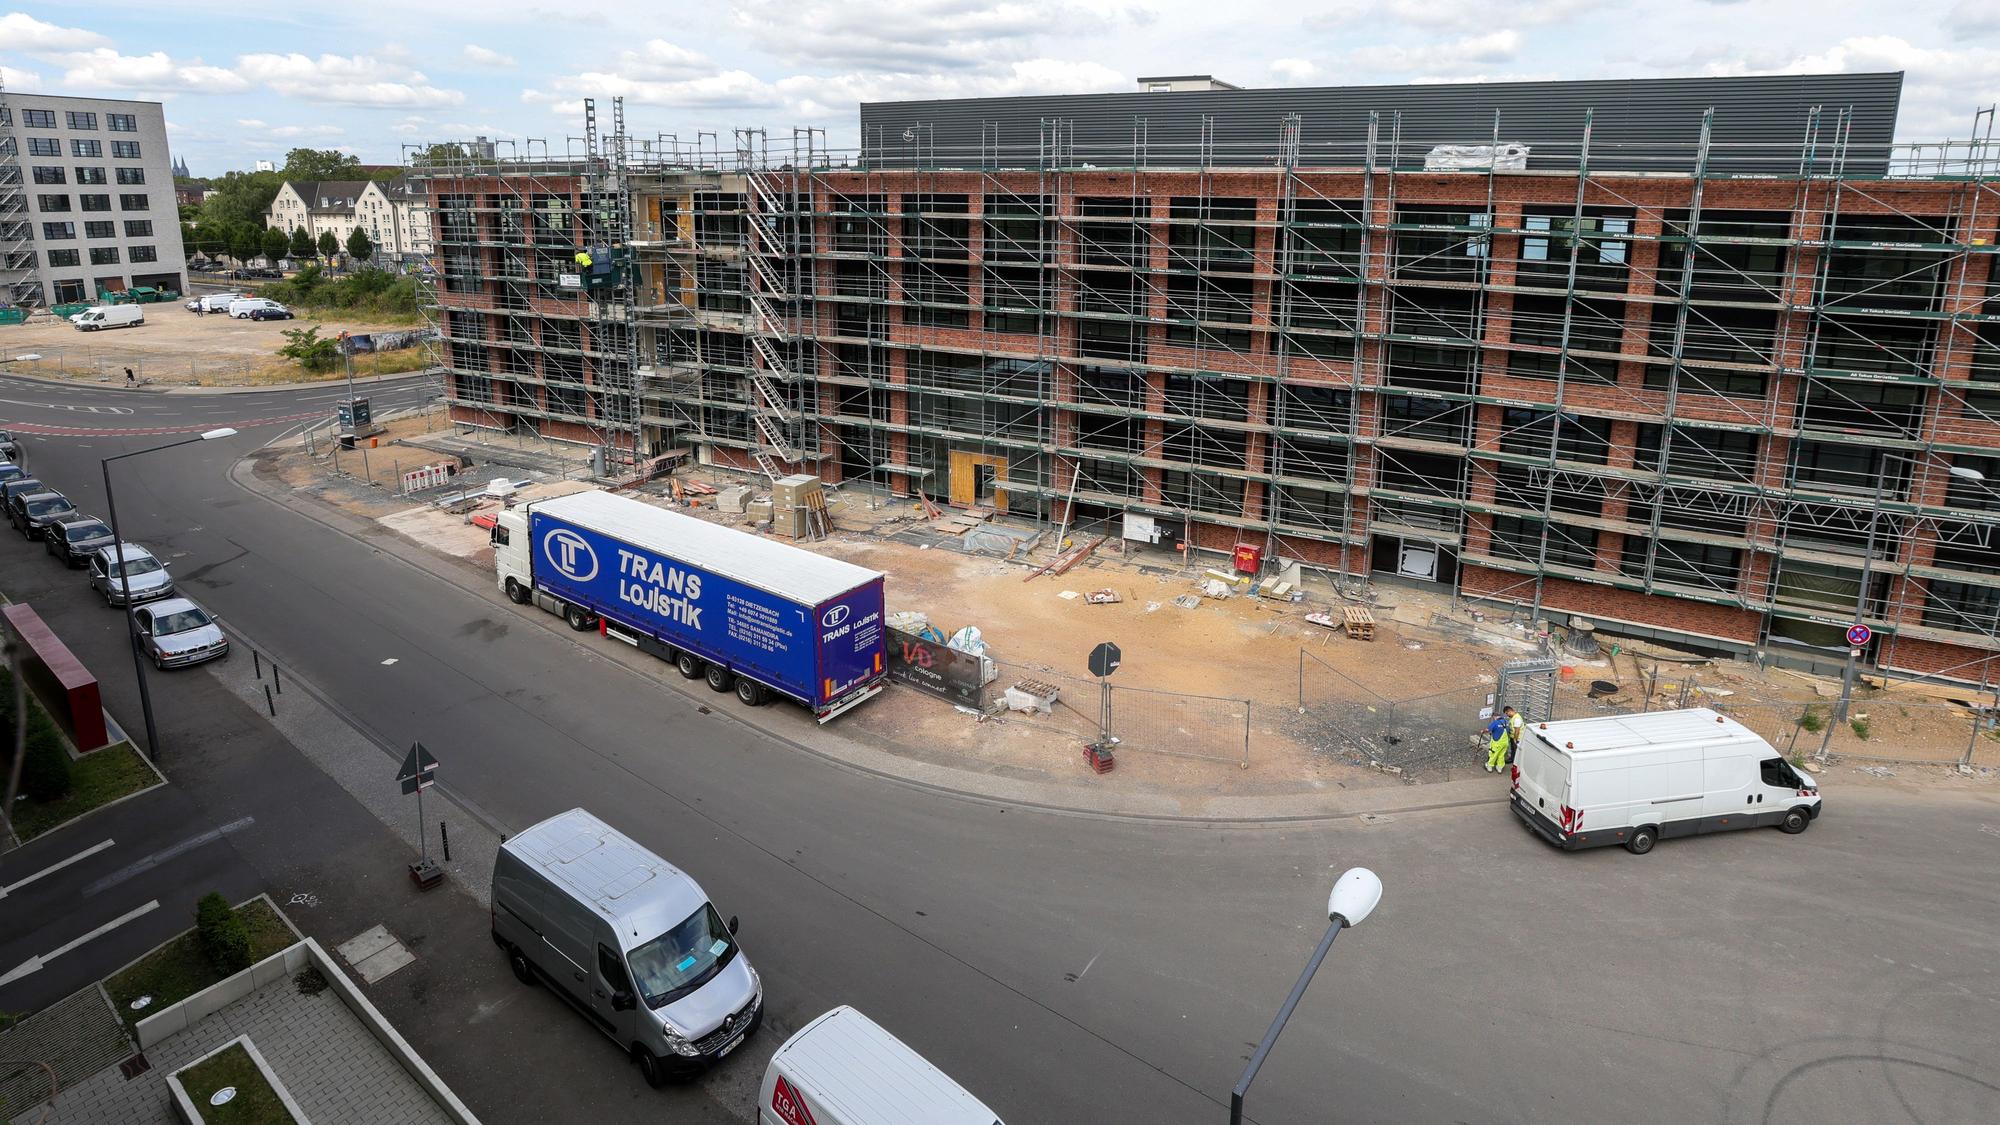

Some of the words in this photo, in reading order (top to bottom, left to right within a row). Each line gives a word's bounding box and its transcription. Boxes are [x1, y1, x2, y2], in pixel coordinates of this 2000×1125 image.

[618, 549, 702, 600] TRANS
[620, 579, 702, 630] LOJİSTİK
[823, 625, 850, 643] TRANS
[915, 666, 941, 680] cologne
[778, 1091, 796, 1118] TGA
